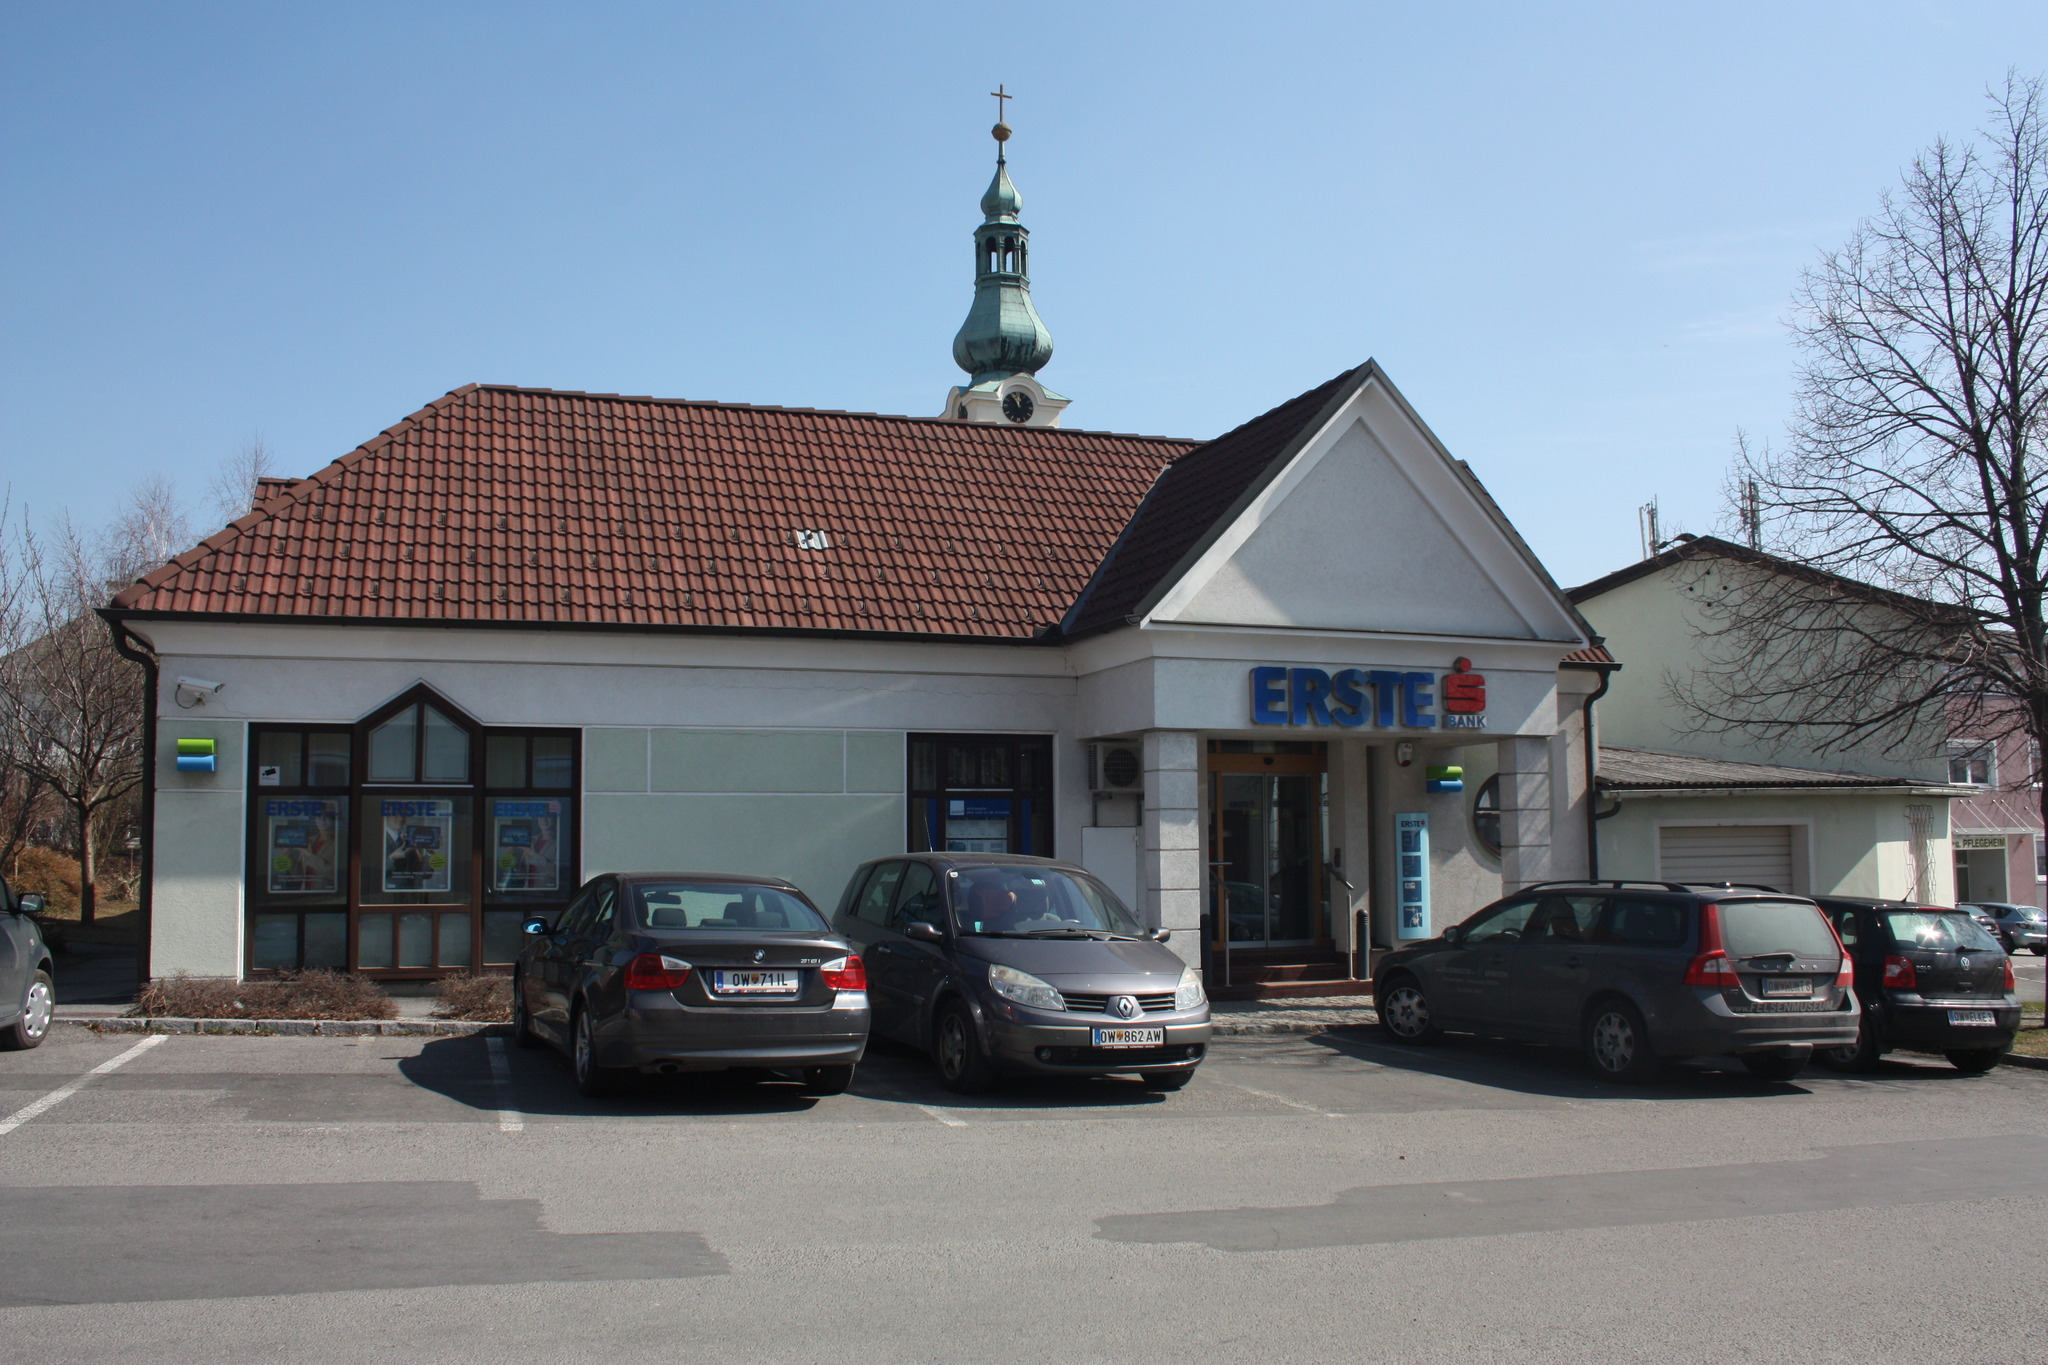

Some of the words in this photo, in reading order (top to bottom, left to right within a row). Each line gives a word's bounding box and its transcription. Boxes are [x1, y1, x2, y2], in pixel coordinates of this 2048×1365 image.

[1251, 666, 1436, 727] ERSTE
[1448, 715, 1486, 728] BANK
[266, 801, 322, 816] ERSTE
[381, 801, 437, 816] ERSTE
[494, 802, 546, 816] ERSTE
[1963, 838, 2005, 847] PFLEGEHEIM
[733, 973, 750, 986] OW
[1101, 1030, 1115, 1043] OW
[1124, 1030, 1144, 1043] 862
[1146, 1030, 1161, 1042] AW
